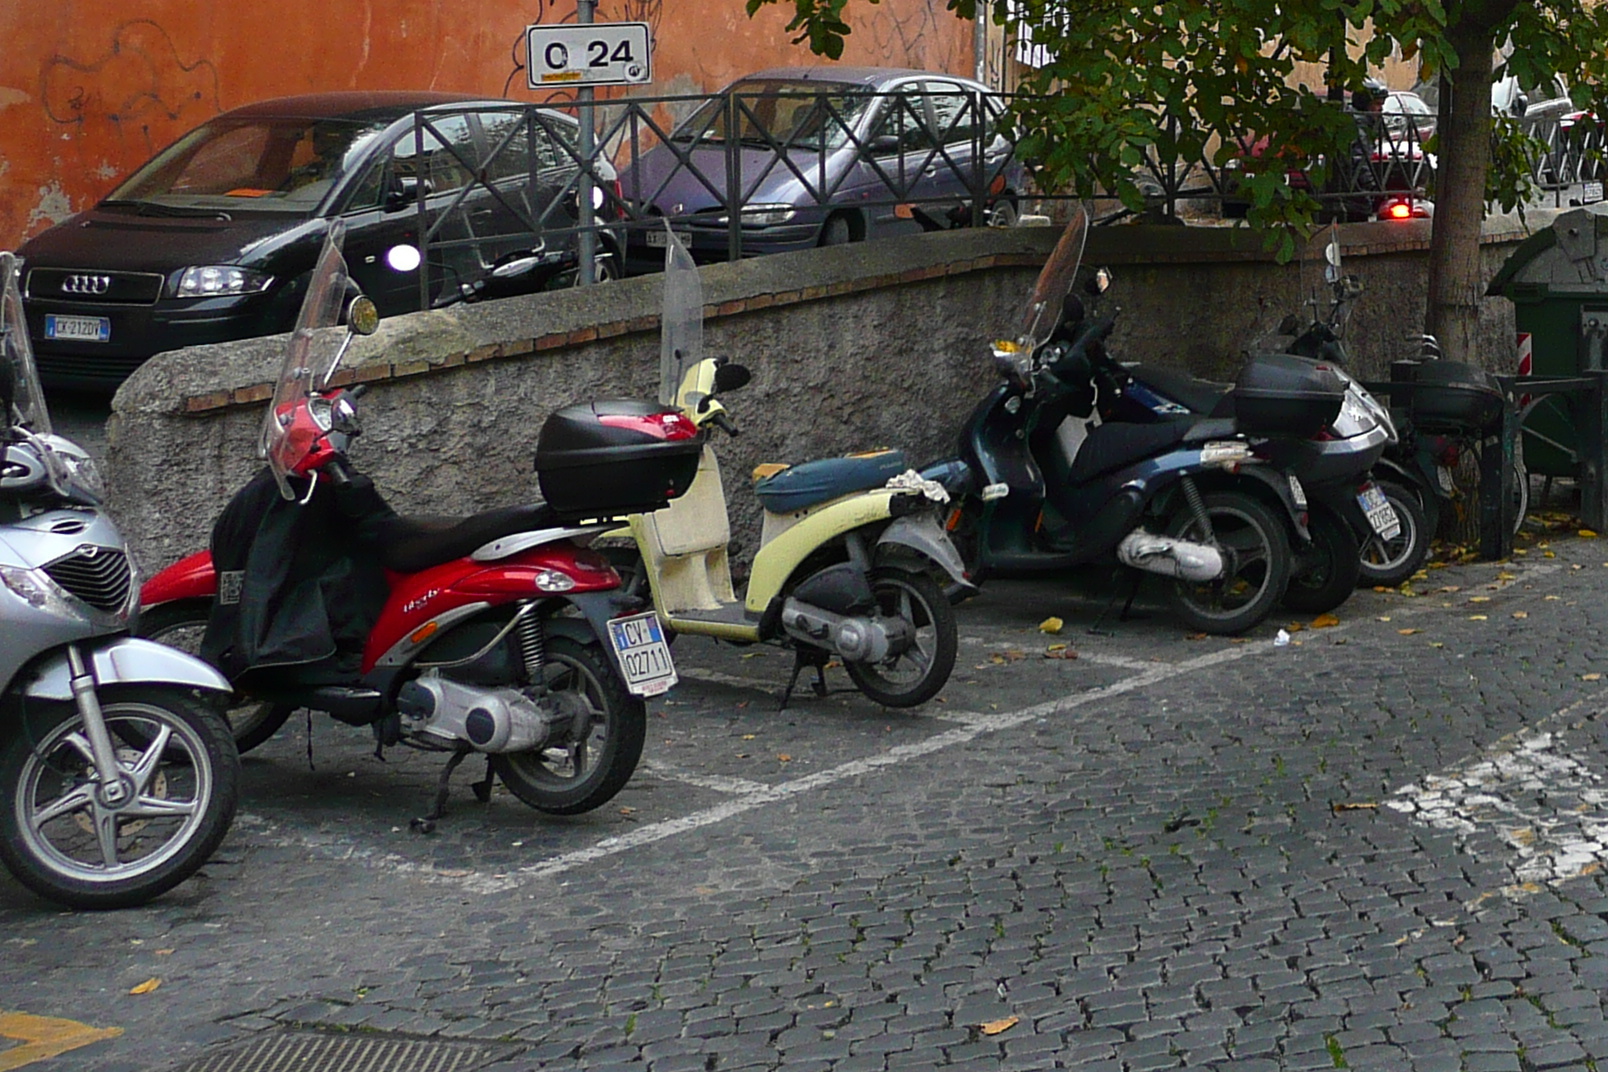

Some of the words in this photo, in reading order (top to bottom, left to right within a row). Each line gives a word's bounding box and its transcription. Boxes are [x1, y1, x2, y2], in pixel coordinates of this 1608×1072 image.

[587, 40, 634, 68] 24
[624, 621, 643, 645] CV
[625, 647, 668, 677] 02711
